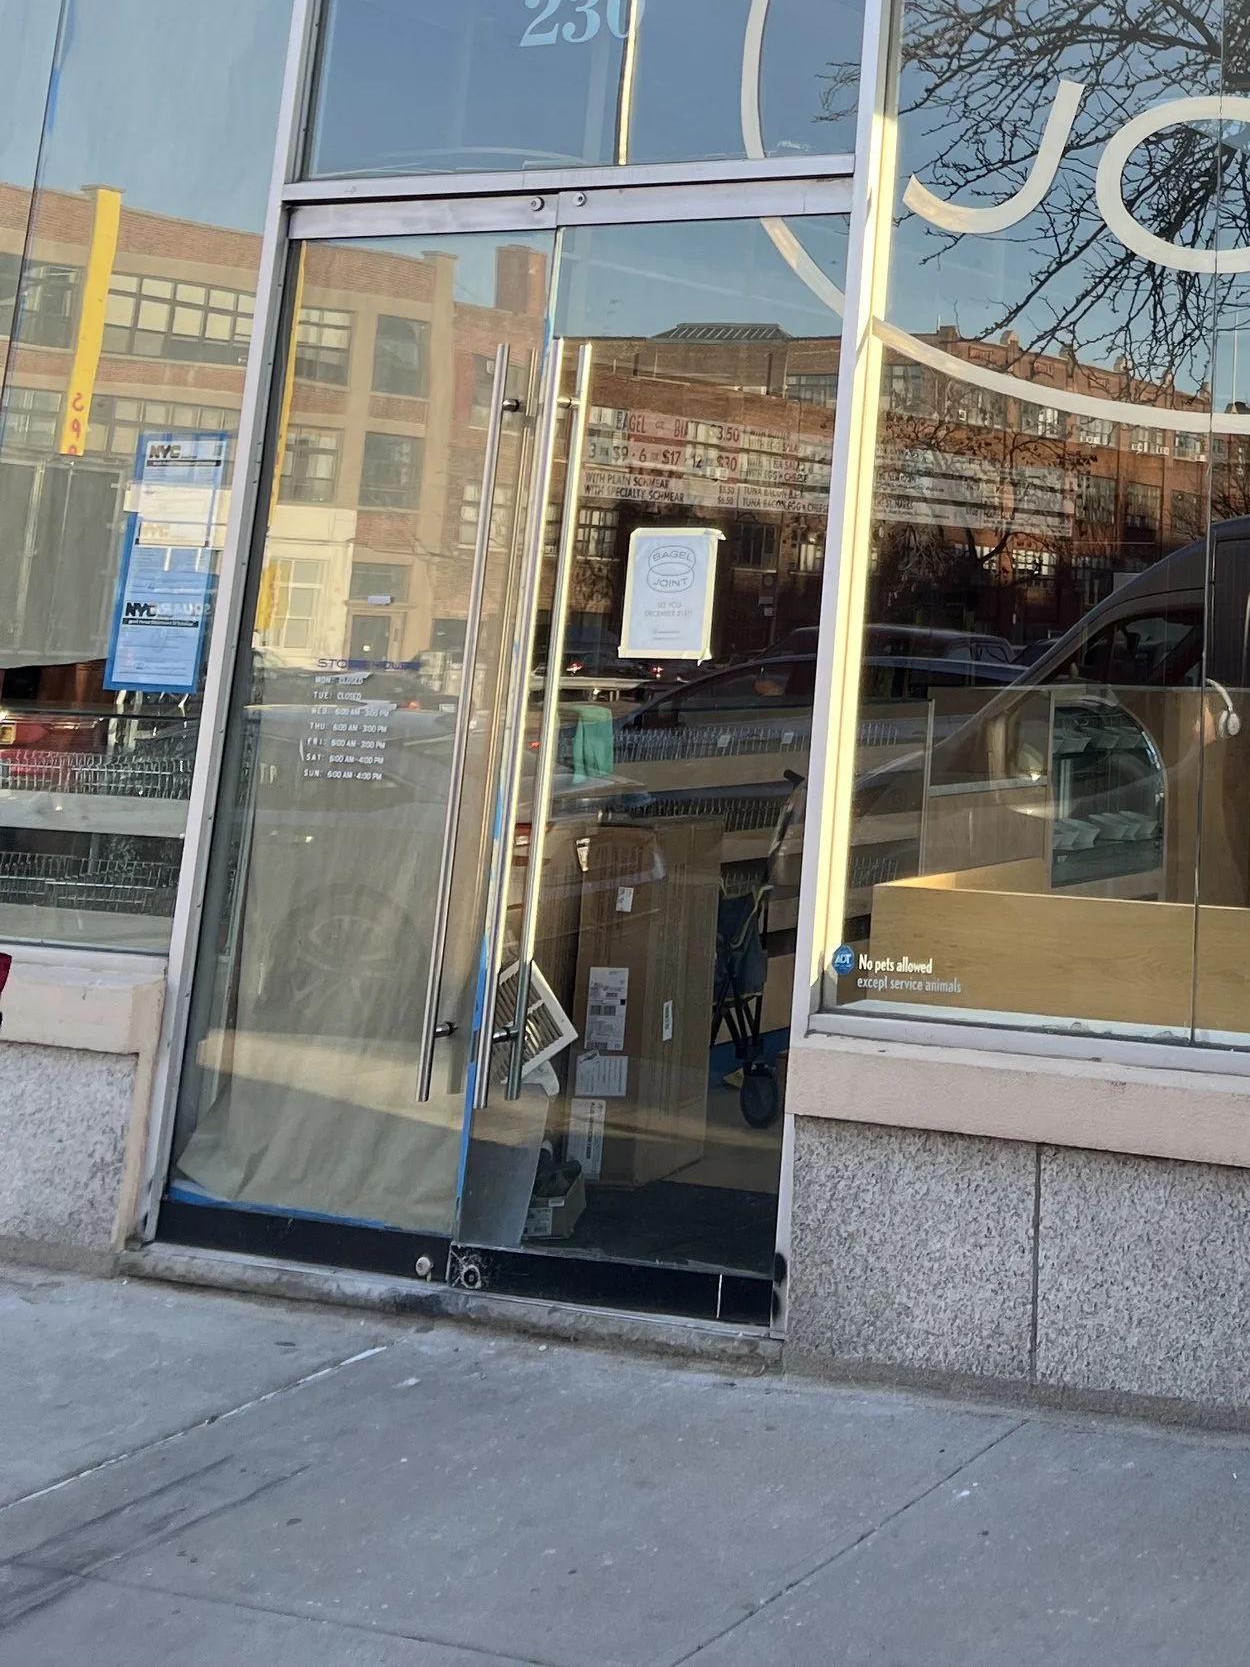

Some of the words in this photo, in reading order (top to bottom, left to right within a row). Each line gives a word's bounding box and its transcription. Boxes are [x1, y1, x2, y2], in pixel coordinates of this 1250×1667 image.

[652, 550, 693, 563] BAGEL
[653, 577, 689, 588] JOINT
[834, 953, 852, 964] ADT
[859, 954, 873, 970] No
[874, 958, 895, 974] pets
[896, 956, 933, 974] allowed
[857, 976, 888, 991] except
[890, 977, 923, 991] service
[925, 978, 962, 994] animals
